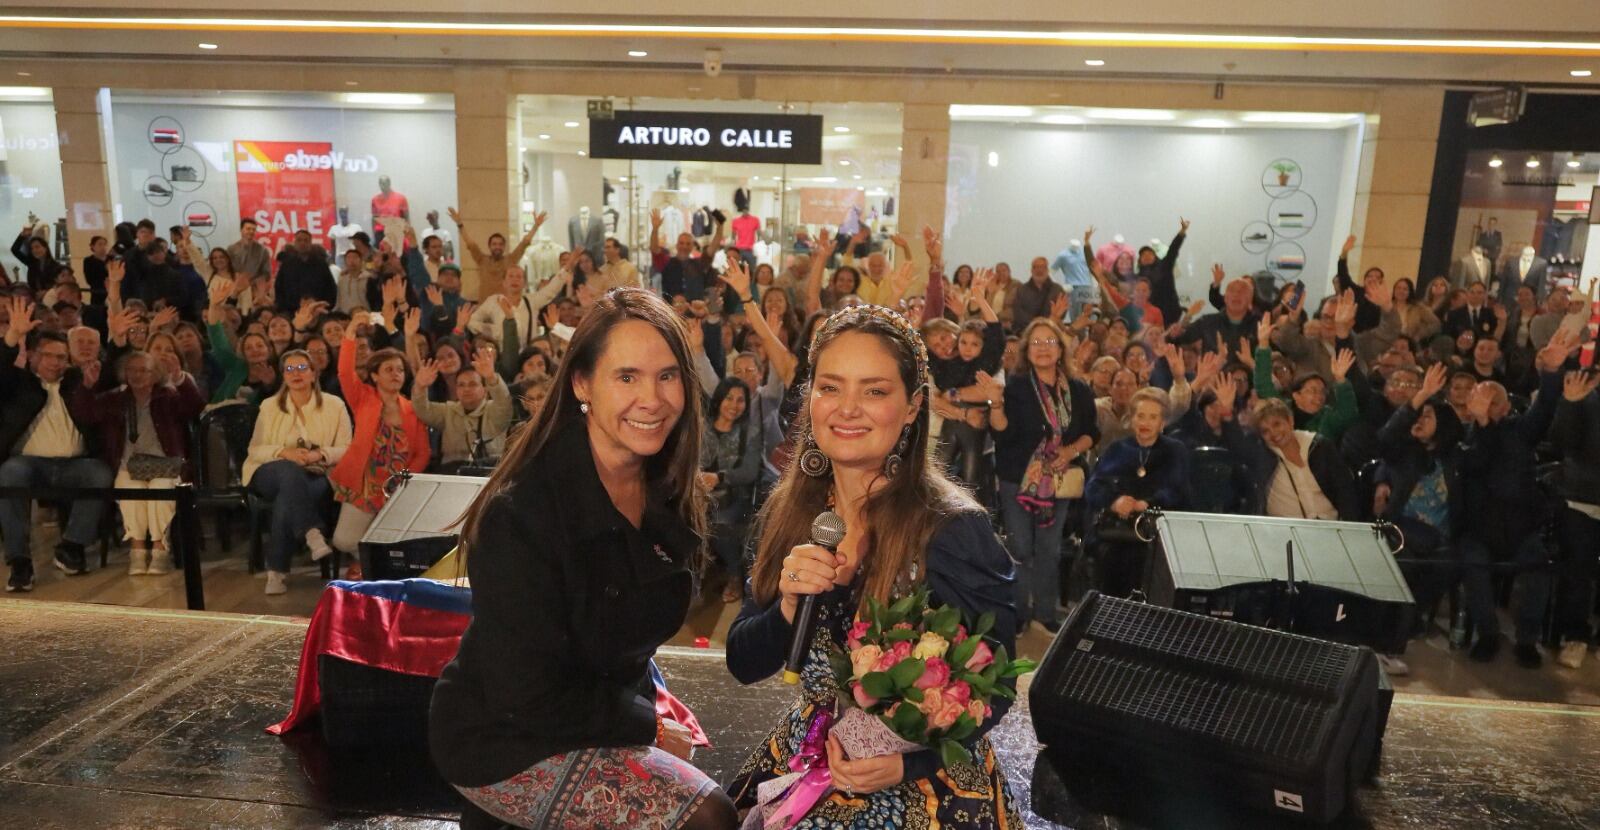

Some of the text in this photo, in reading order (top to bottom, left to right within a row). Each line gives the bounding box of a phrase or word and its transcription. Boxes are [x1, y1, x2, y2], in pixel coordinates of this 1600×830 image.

[618, 126, 793, 149] ARTURO CALLE
[254, 209, 323, 234] SALE
[1278, 794, 1302, 808] 4
